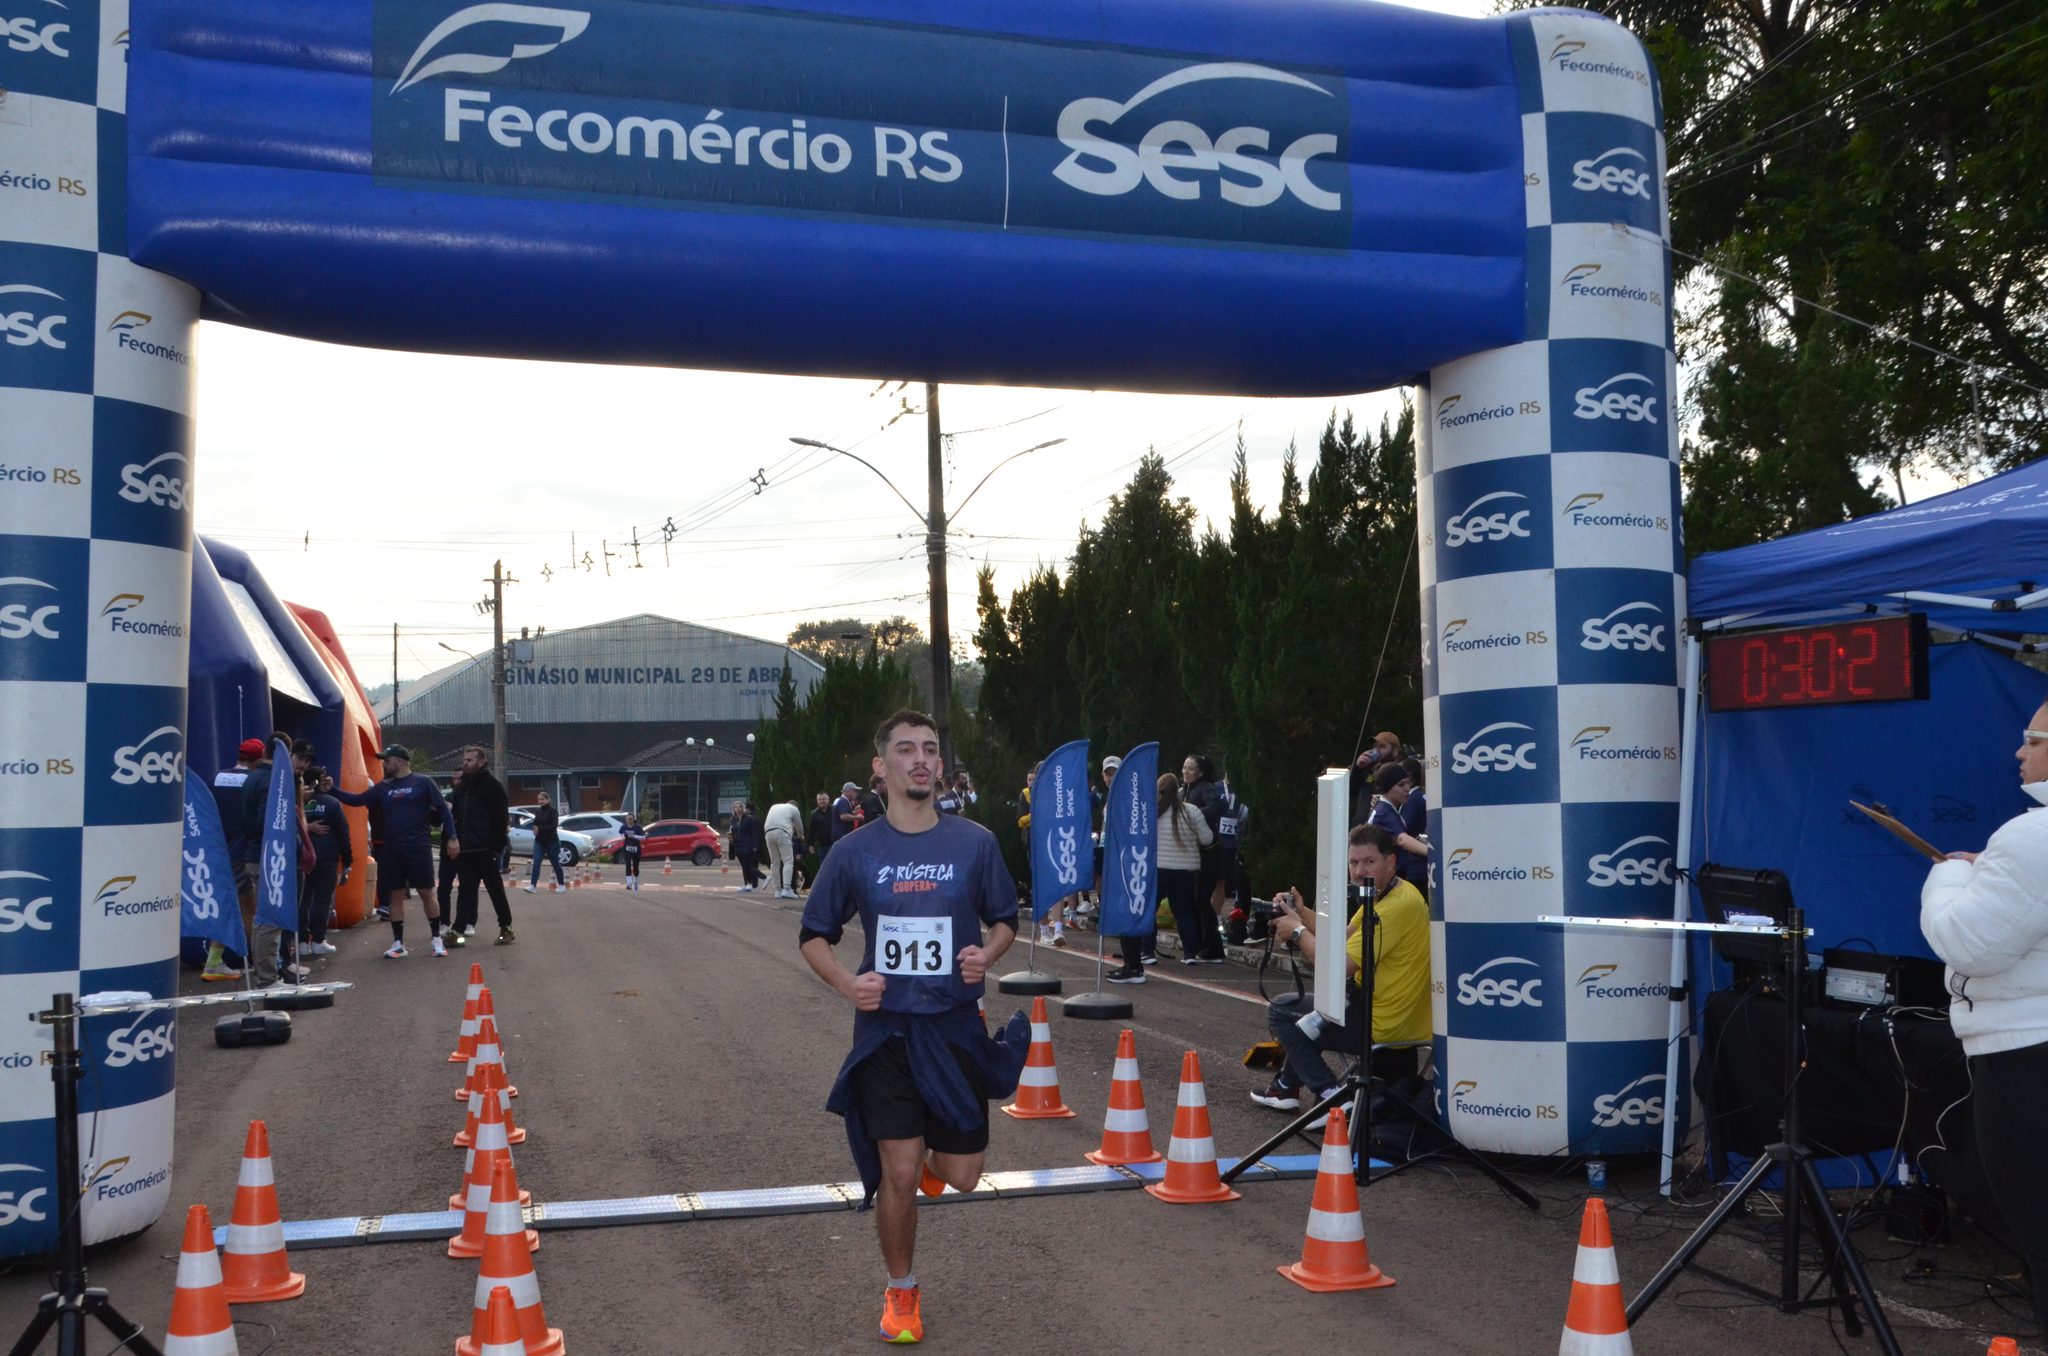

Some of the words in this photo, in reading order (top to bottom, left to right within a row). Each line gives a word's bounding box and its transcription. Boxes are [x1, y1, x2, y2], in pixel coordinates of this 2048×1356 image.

[1560, 59, 1635, 80] Fecomércio
[444, 88, 852, 173] Fecomércio
[874, 126, 963, 183] RS
[1052, 62, 1342, 211] Sesc
[58, 177, 87, 196] RS
[1572, 147, 1651, 200] Sesc
[1571, 284, 1647, 301] Fecomércio
[1650, 292, 1662, 306] RS
[1573, 372, 1658, 424] Sesc
[1440, 405, 1514, 430] Fecomércio
[1519, 401, 1541, 415] RS
[53, 468, 81, 485] RS
[1445, 491, 1530, 547] Sesc
[1573, 513, 1653, 528] Fecomércio
[1656, 517, 1668, 530] RS
[112, 616, 182, 638] Fecomércio
[1446, 634, 1521, 653] Fecomércio
[1526, 631, 1548, 645] RS
[1580, 601, 1665, 652] Sesc
[504, 664, 579, 684] GINÁSIO
[585, 667, 686, 684] MUNICIPAL
[692, 667, 715, 683] 29
[720, 667, 742, 683] DE
[1451, 722, 1536, 774] Sesc
[1580, 746, 1661, 760] Fecomércio
[1664, 747, 1677, 760] RS
[47, 758, 74, 775] RS
[1047, 826, 1077, 885] Sesc
[1587, 835, 1673, 887] Sesc
[182, 848, 219, 920] Sesc
[264, 840, 287, 908] Sesc
[1120, 846, 1148, 916] Sesc
[1452, 866, 1527, 880] Fecomércio
[1532, 866, 1554, 880] RS
[104, 896, 174, 917] Fecomércio
[884, 939, 943, 971] 913
[1457, 956, 1542, 1008] Sesc
[1586, 982, 1669, 998] Fecomércio
[1456, 1099, 1531, 1118] Fecomércio
[1536, 1105, 1558, 1119] RS
[1592, 1074, 1679, 1128] Ses
[98, 1168, 167, 1200] Fecomércio
